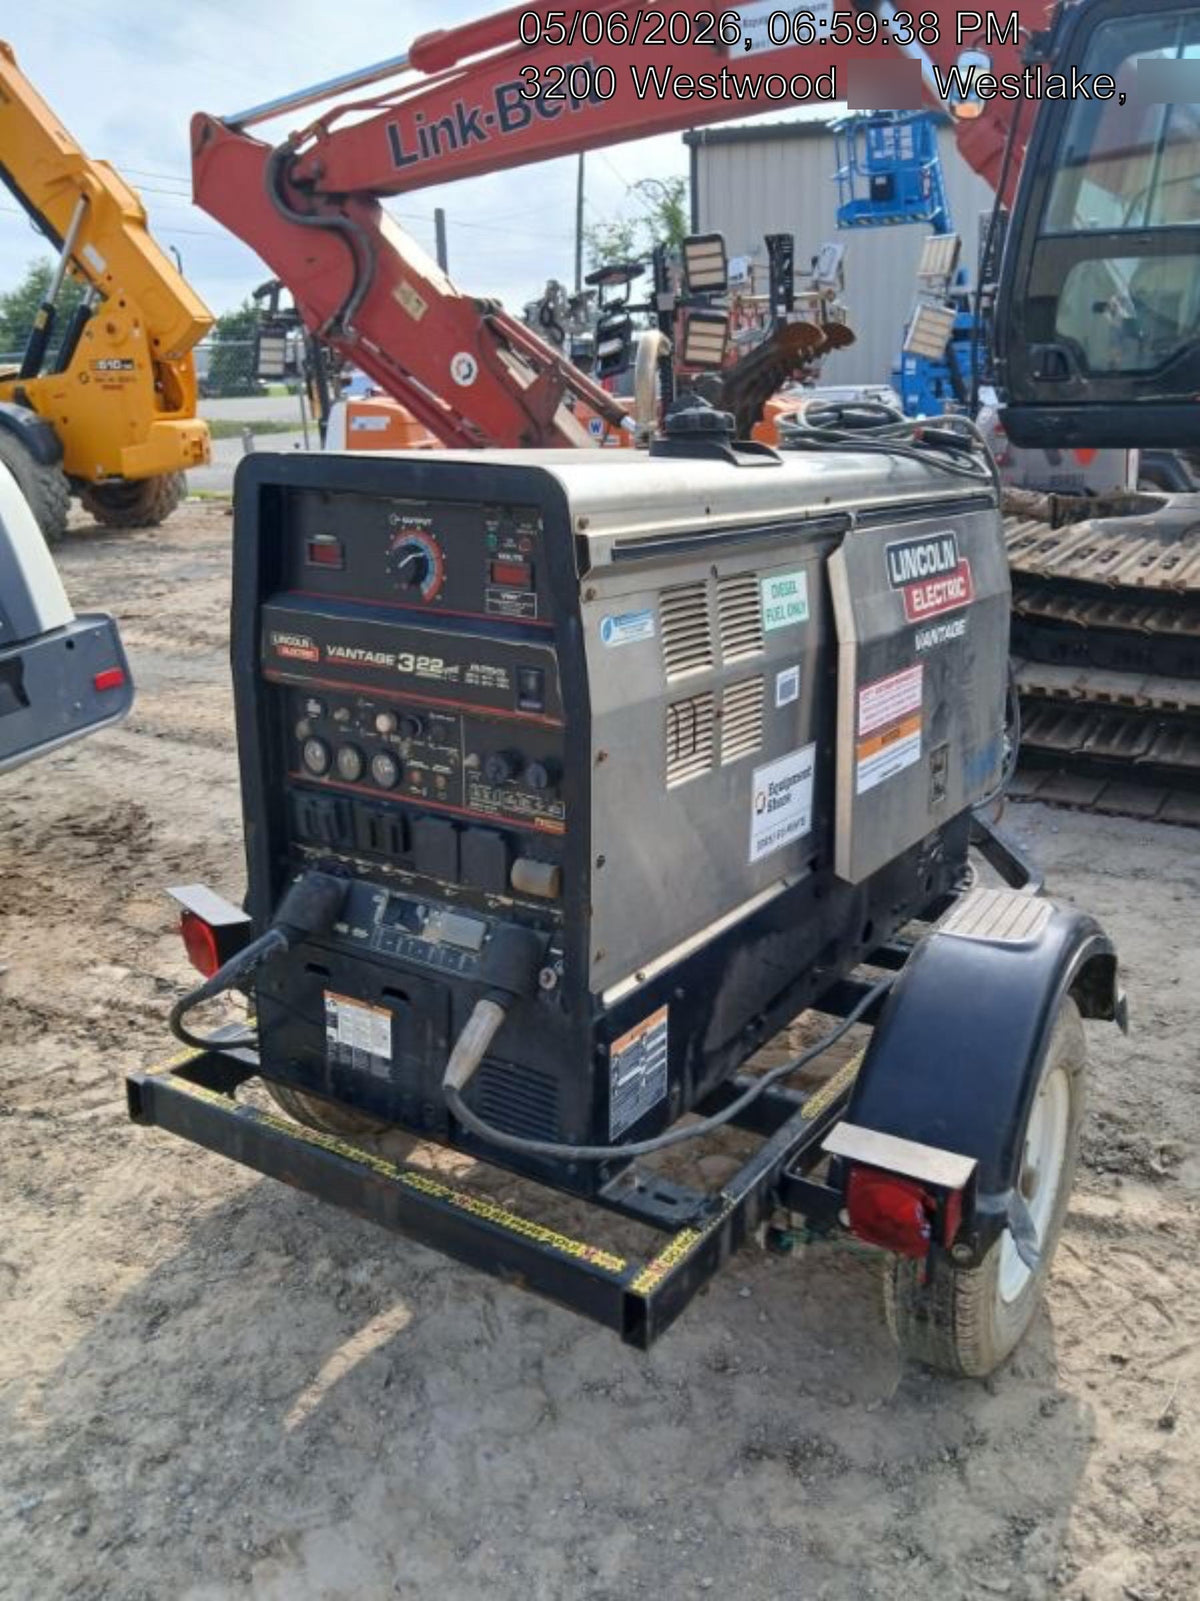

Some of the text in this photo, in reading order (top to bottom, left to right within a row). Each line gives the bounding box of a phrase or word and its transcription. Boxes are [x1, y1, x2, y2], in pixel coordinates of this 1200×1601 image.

[890, 539, 957, 582] LINCOLN
[911, 576, 967, 612] ELECTRIC
[766, 605, 786, 624] FUEL
[914, 618, 967, 650] VANTAGE
[326, 644, 395, 666] VANTAGE
